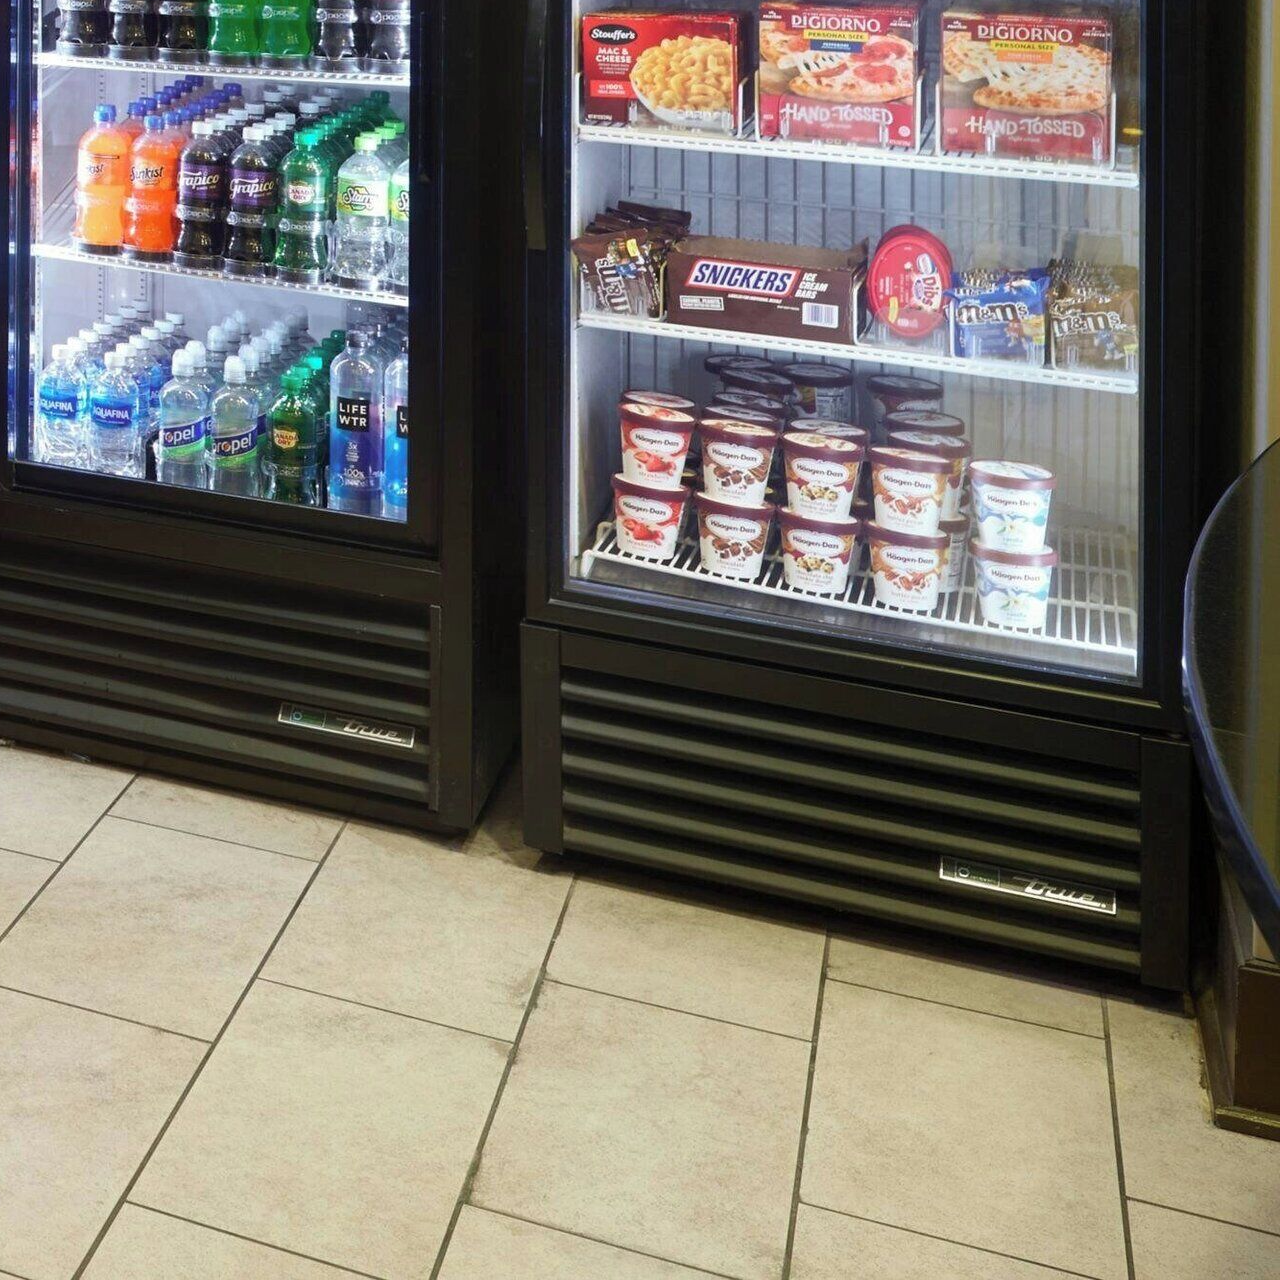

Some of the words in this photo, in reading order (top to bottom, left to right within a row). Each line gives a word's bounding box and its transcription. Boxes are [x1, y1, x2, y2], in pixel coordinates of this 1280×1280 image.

[591, 28, 636, 41] Stouffer's
[846, 33, 865, 41] SIZE
[977, 24, 1074, 43] DIGIORNO
[598, 47, 619, 56] MAC
[620, 47, 629, 56] &
[994, 41, 1036, 51] PERSONAL
[1037, 42, 1056, 51] SIZE
[595, 55, 632, 64] CHEESE
[780, 102, 893, 126] HAND-TOSSED
[964, 115, 1086, 139] HAND-TOSSED
[129, 163, 164, 183] Sunkist
[229, 177, 276, 200] Grapico
[693, 263, 793, 293] SNICKERS
[803, 272, 816, 280] ICE
[595, 257, 630, 315] m&m's
[799, 281, 829, 292] CREAM
[921, 276, 940, 308] Dibs
[795, 289, 818, 299] BARS
[957, 302, 1029, 325] m&m's
[1053, 312, 1122, 338] m&m's
[338, 402, 367, 415] LIFE
[338, 414, 367, 427] WTR
[212, 434, 253, 458] propel
[277, 438, 292, 446] DRY
[634, 432, 680, 447] Häagen-Dazs
[711, 448, 758, 463] Häagen-Dazs
[796, 462, 844, 478] Häagen-Dazs
[710, 519, 757, 534] Häagen-Dazs
[792, 535, 840, 550] Häagen-Dazs
[336, 717, 403, 742] True
[1012, 876, 1102, 908] True
